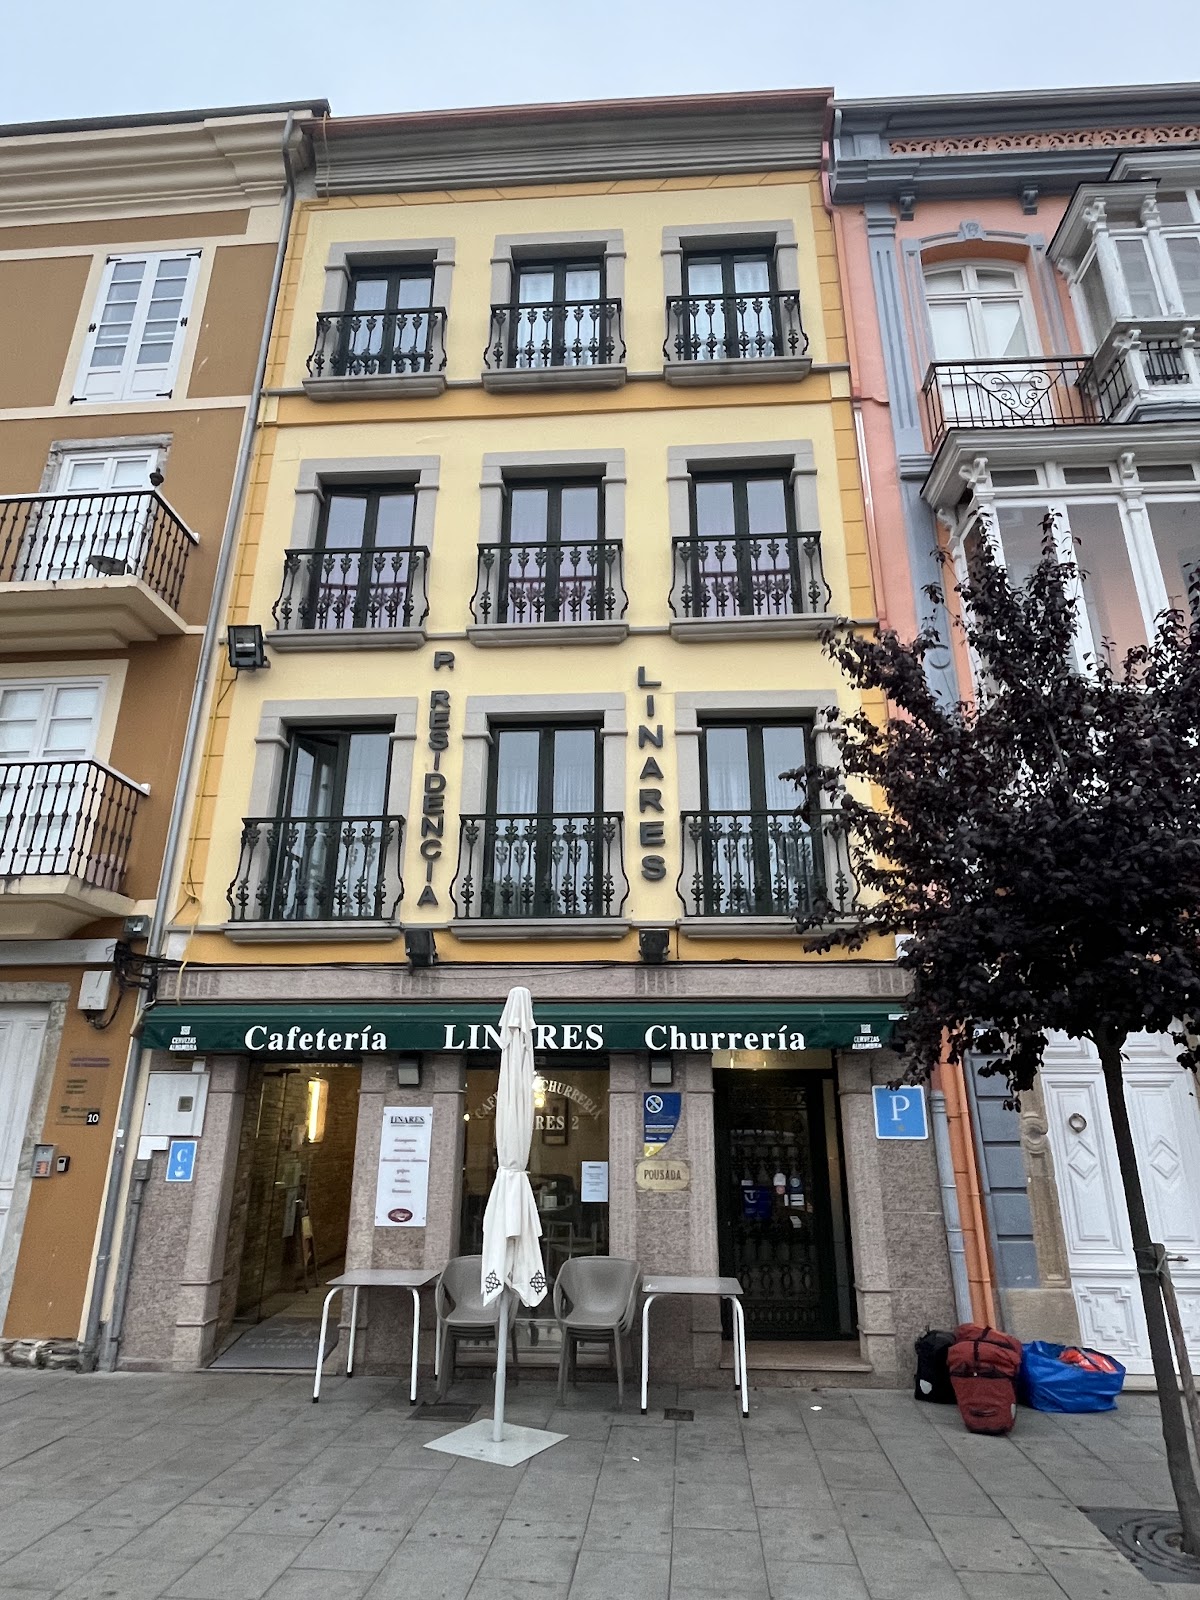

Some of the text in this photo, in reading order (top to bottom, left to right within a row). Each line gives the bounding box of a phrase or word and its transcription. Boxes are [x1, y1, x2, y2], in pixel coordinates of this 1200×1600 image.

[637, 666, 667, 881] LINARES
[417, 690, 450, 907] RESIDENCIA
[244, 1025, 387, 1051] Cafetería
[443, 1024, 604, 1050] LINRES
[645, 1025, 806, 1050] Churrería
[87, 1113, 99, 1123] 10
[889, 1095, 910, 1121] P
[571, 1116, 580, 1130] 2
[176, 1148, 188, 1163] C
[643, 1169, 682, 1181] POUSADA
